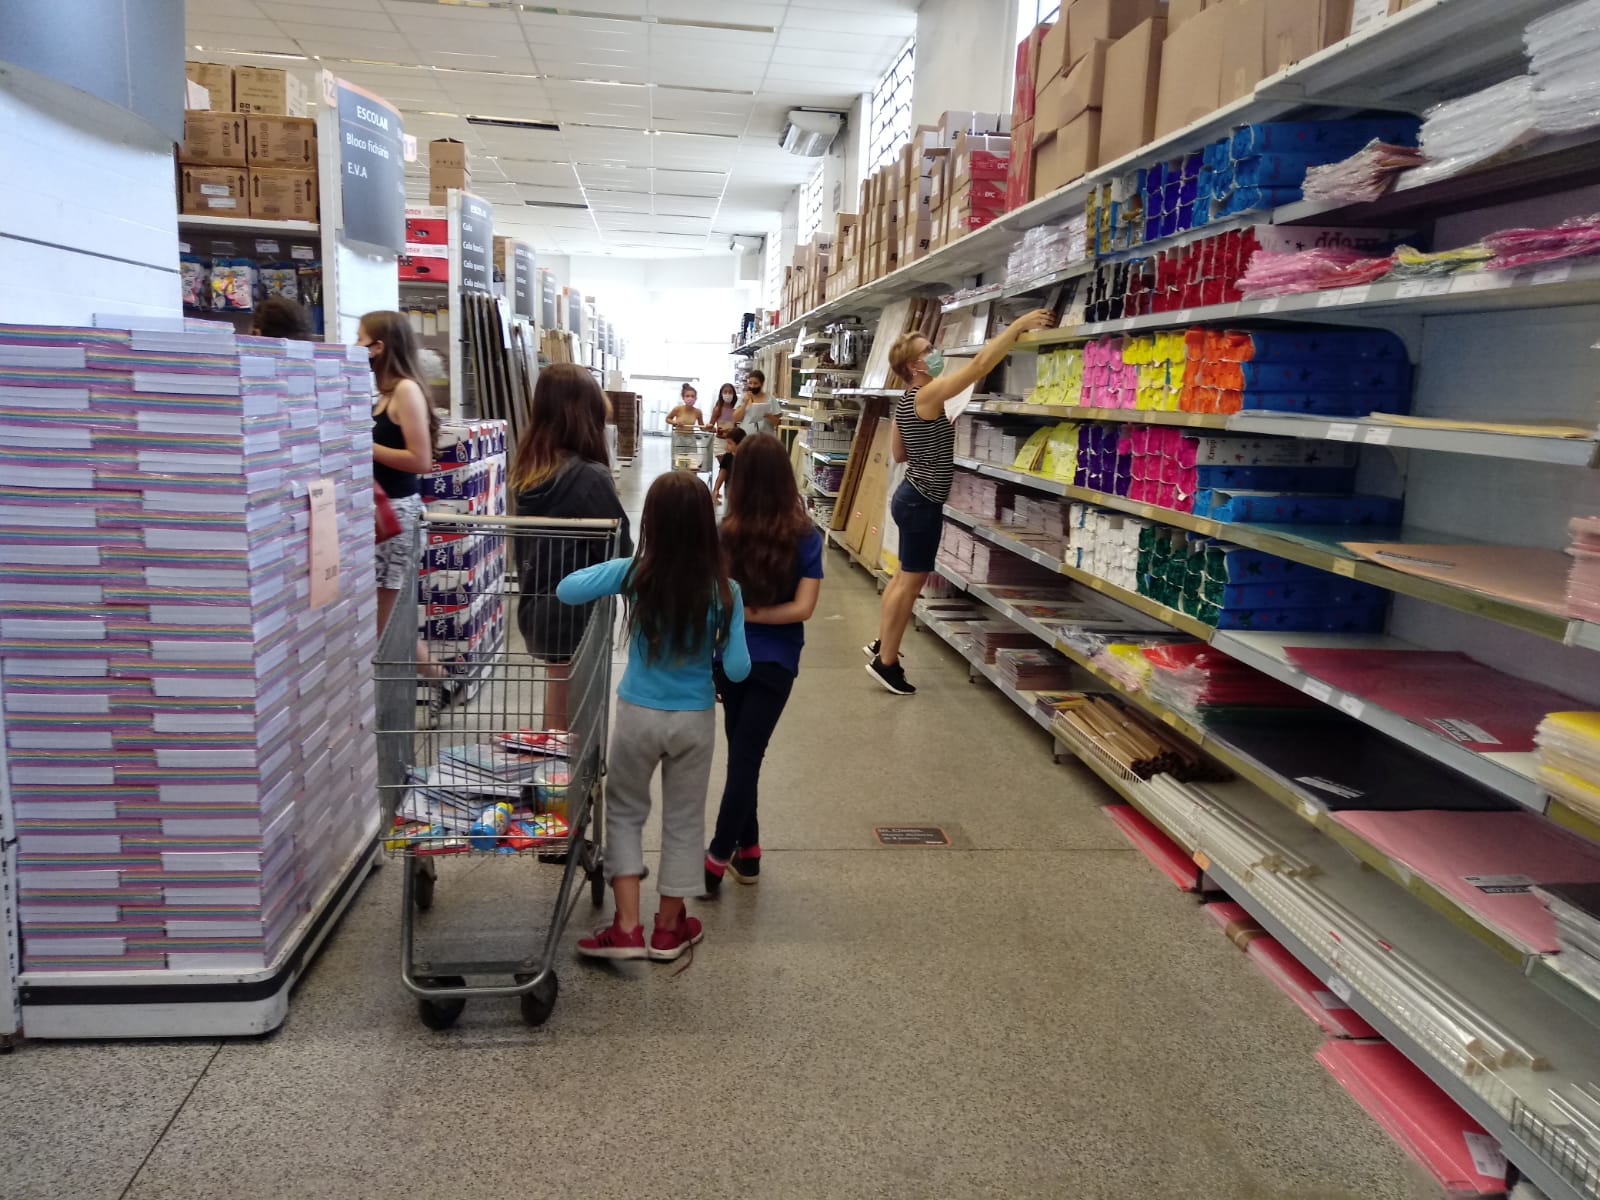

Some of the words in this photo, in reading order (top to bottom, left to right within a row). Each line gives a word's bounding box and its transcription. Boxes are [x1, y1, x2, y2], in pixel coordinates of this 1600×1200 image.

[356, 105, 389, 131] ESCOLAR
[346, 132, 366, 150] Bloco
[347, 161, 368, 179] E.V.A
